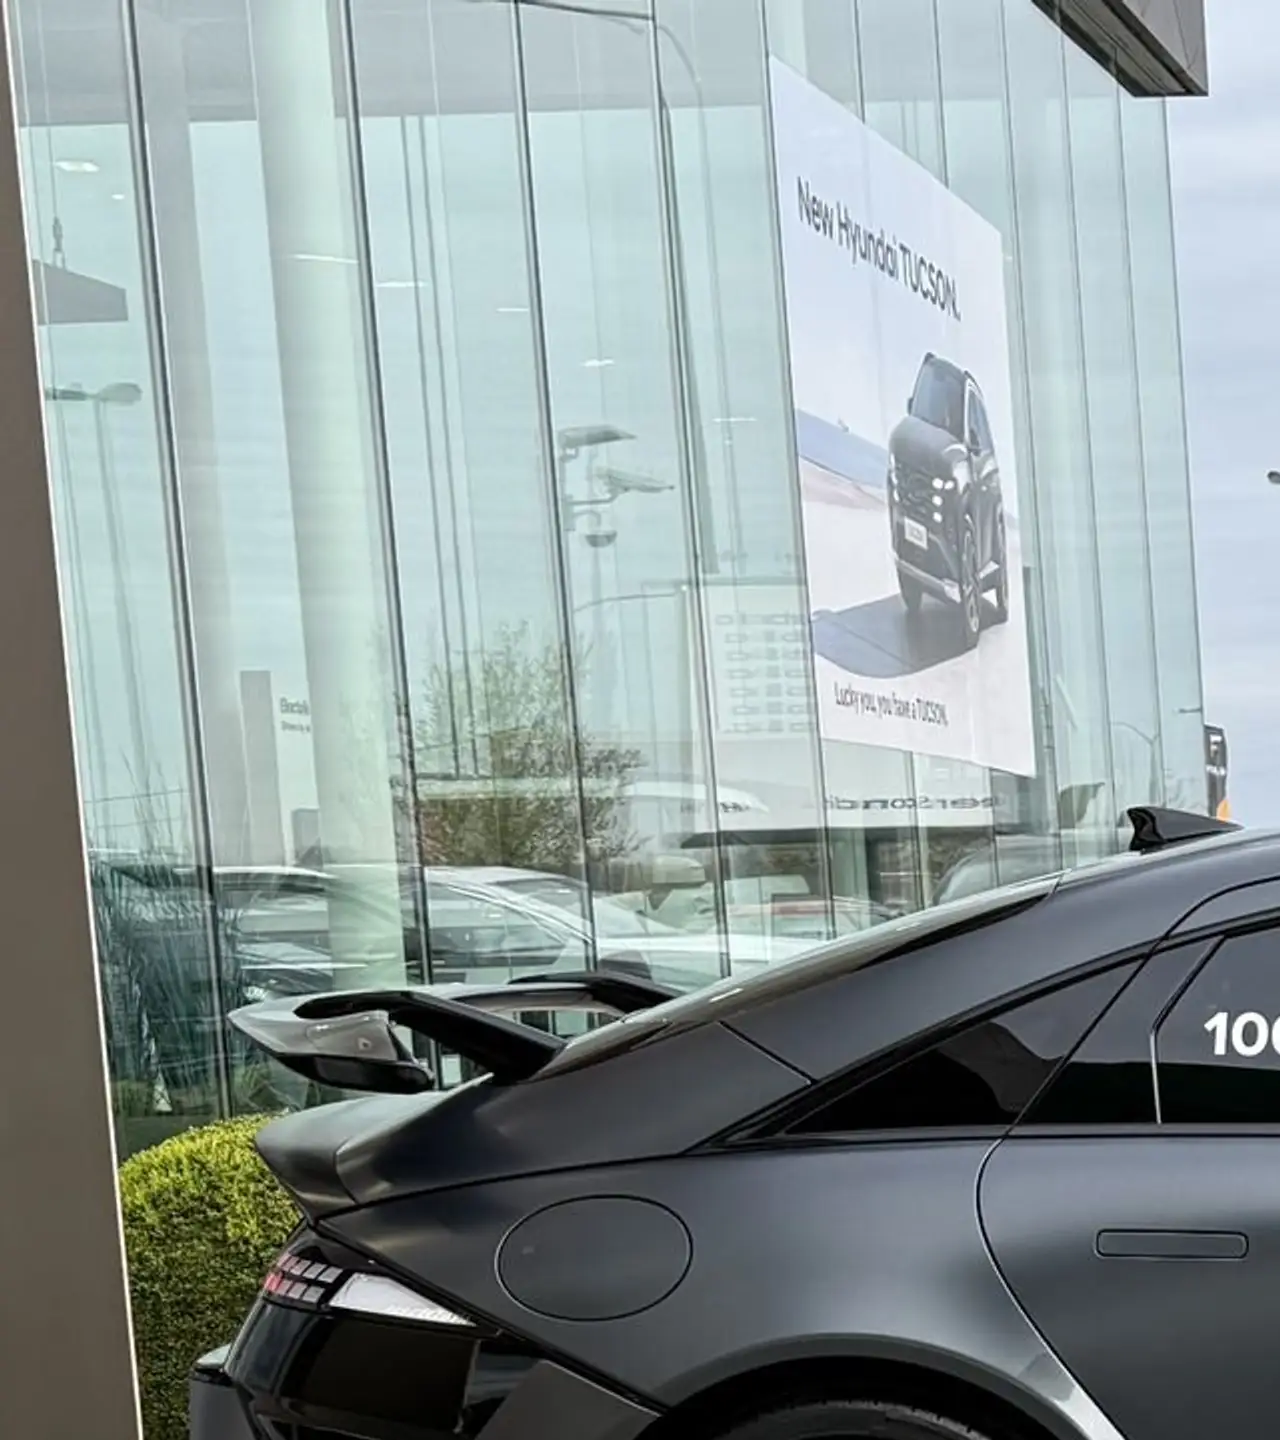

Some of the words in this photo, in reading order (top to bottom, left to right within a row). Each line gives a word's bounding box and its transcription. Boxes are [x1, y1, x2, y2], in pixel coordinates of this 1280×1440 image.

[797, 176, 833, 240] New
[836, 201, 899, 281] Hyundai
[899, 242, 962, 322] TUCSON.
